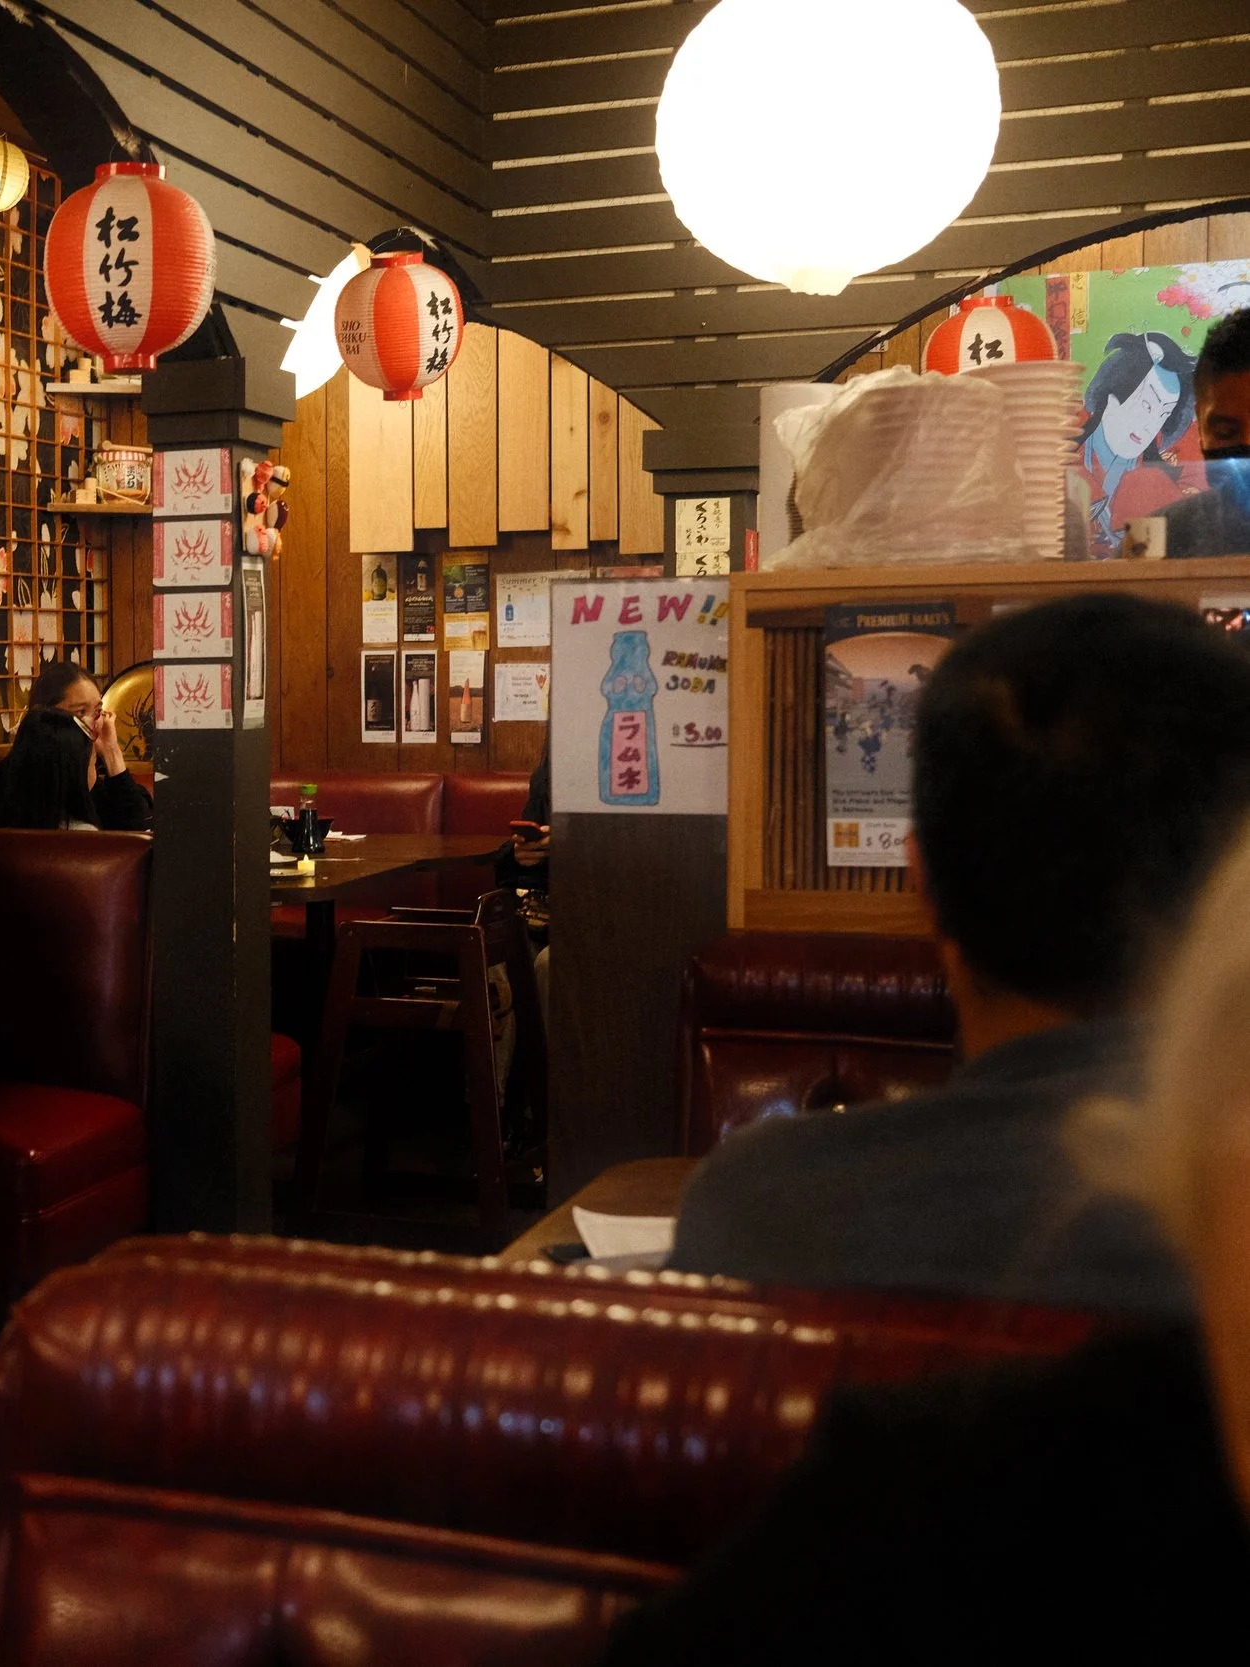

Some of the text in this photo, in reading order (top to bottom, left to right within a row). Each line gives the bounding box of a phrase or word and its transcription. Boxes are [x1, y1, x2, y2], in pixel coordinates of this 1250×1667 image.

[95, 206, 142, 328] 松竹梅
[426, 291, 454, 374] 松竹梅
[666, 675, 715, 694] SODA
[618, 715, 641, 790] ラムネ
